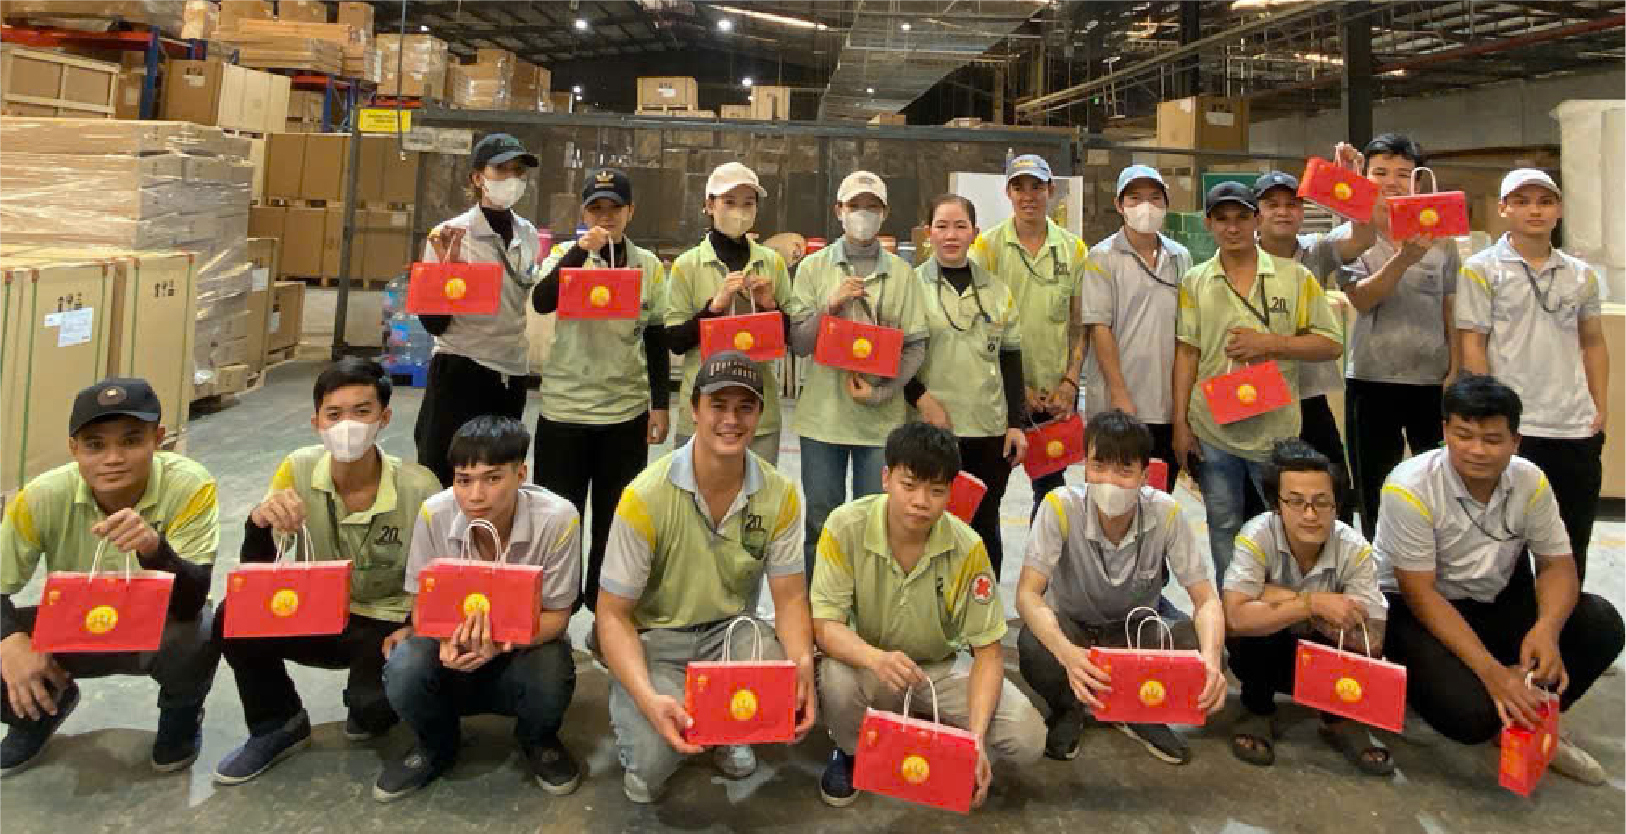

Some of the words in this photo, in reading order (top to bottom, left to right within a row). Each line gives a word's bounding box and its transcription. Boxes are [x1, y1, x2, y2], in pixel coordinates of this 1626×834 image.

[1271, 296, 1287, 310] 20
[746, 513, 762, 530] 20
[378, 525, 400, 543] 20
